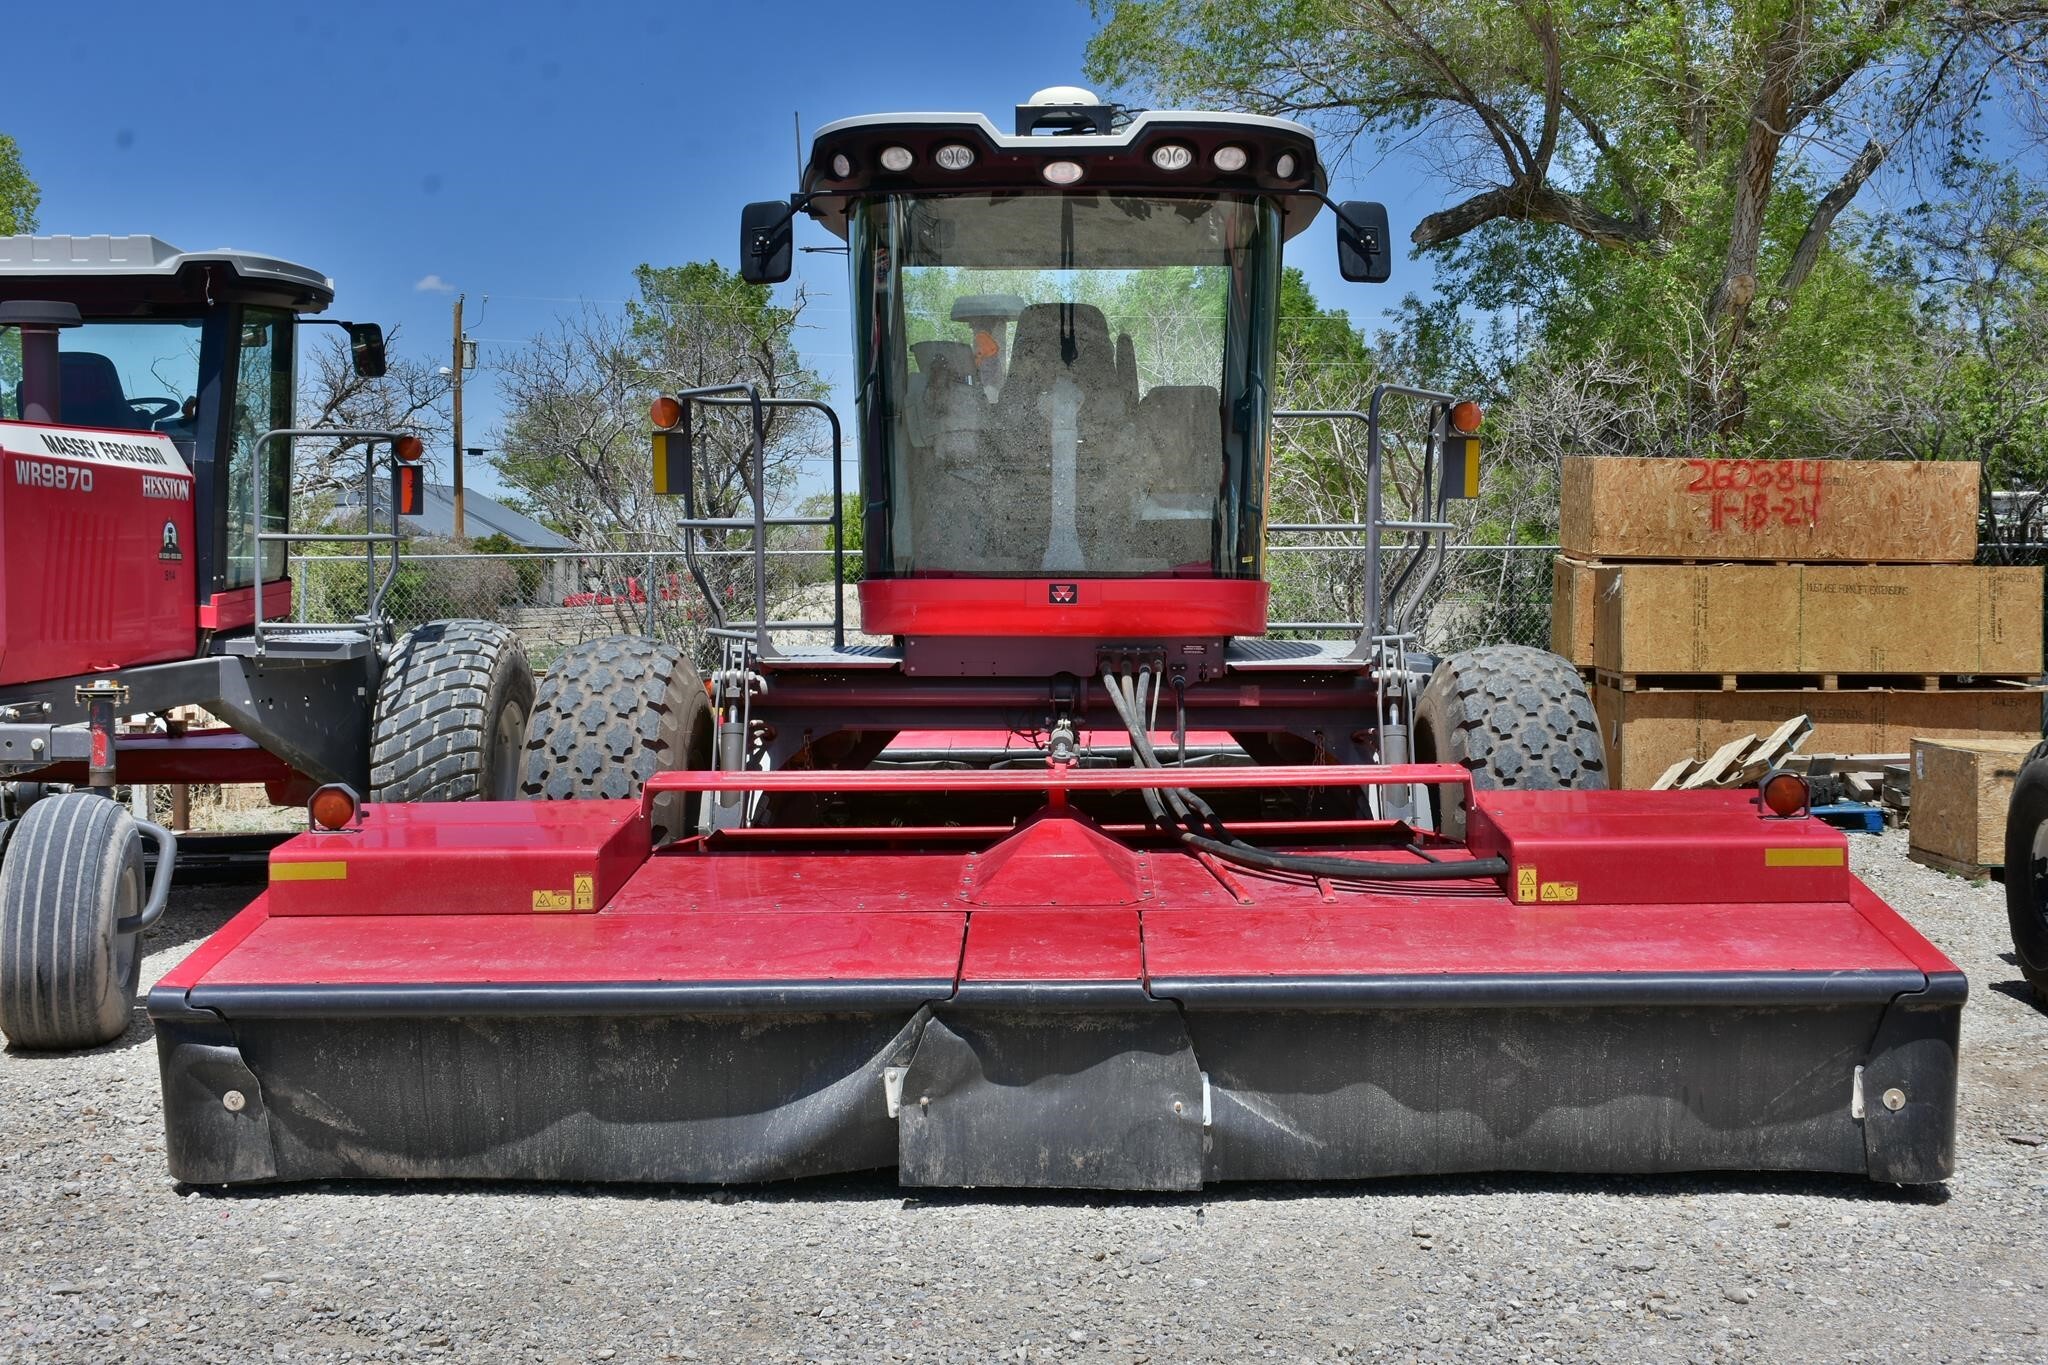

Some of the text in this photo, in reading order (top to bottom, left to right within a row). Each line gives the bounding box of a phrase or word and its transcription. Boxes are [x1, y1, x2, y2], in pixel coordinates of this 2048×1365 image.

[40, 433, 168, 465] MASSEY FERGUSON
[15, 459, 93, 492] WR9870
[142, 475, 190, 500] HESSTON
[1687, 460, 1823, 493] 260684
